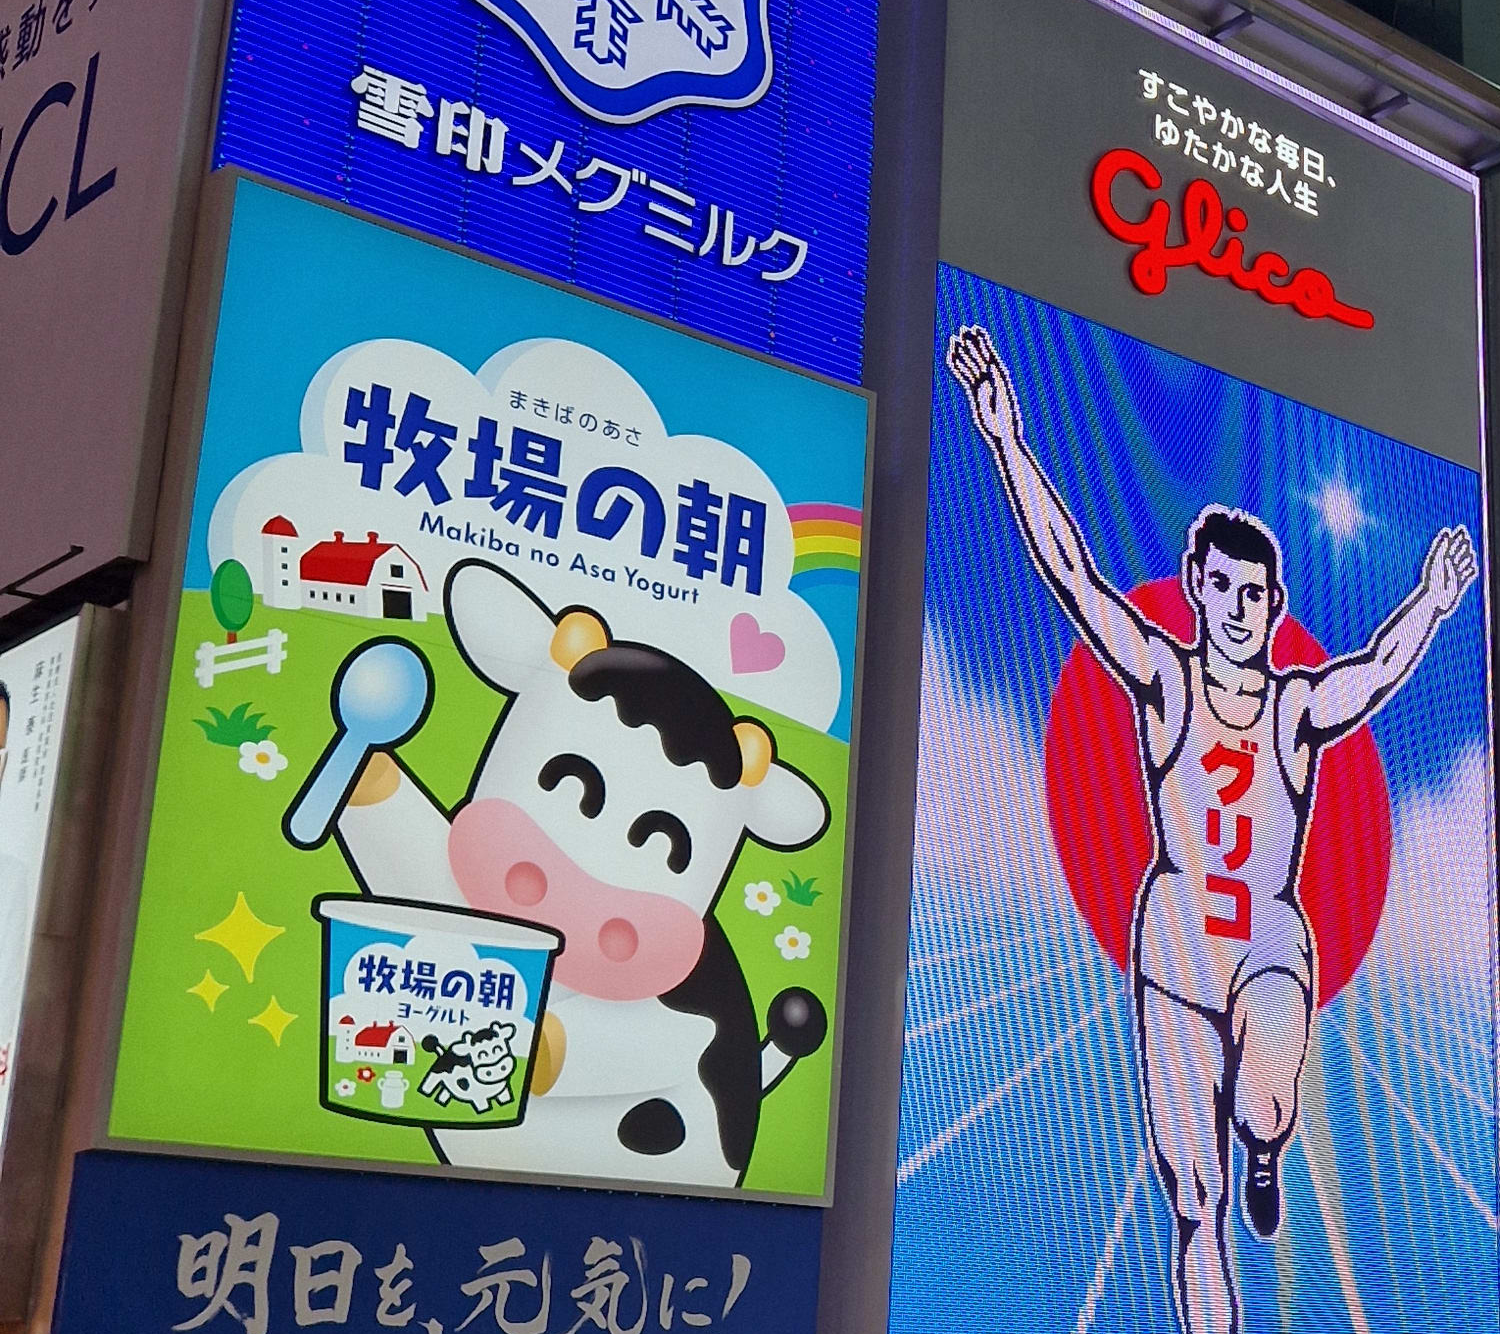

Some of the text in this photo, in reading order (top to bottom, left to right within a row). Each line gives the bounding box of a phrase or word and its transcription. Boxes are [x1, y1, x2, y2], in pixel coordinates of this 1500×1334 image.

[0, 51, 117, 256] CL
[350, 65, 808, 281] 雪印メグミルク
[1137, 68, 1336, 188] すこやかな毎日、
[1154, 114, 1319, 217] ゆたかな人生
[509, 389, 643, 447] まきばのあさ
[343, 383, 767, 596] 牧場の朝
[419, 511, 699, 608] Makiba no Asa Yogurt
[1201, 739, 1258, 942] グリコ
[358, 954, 516, 1011] 牧場の朝
[397, 1003, 470, 1026] ヨーグルト
